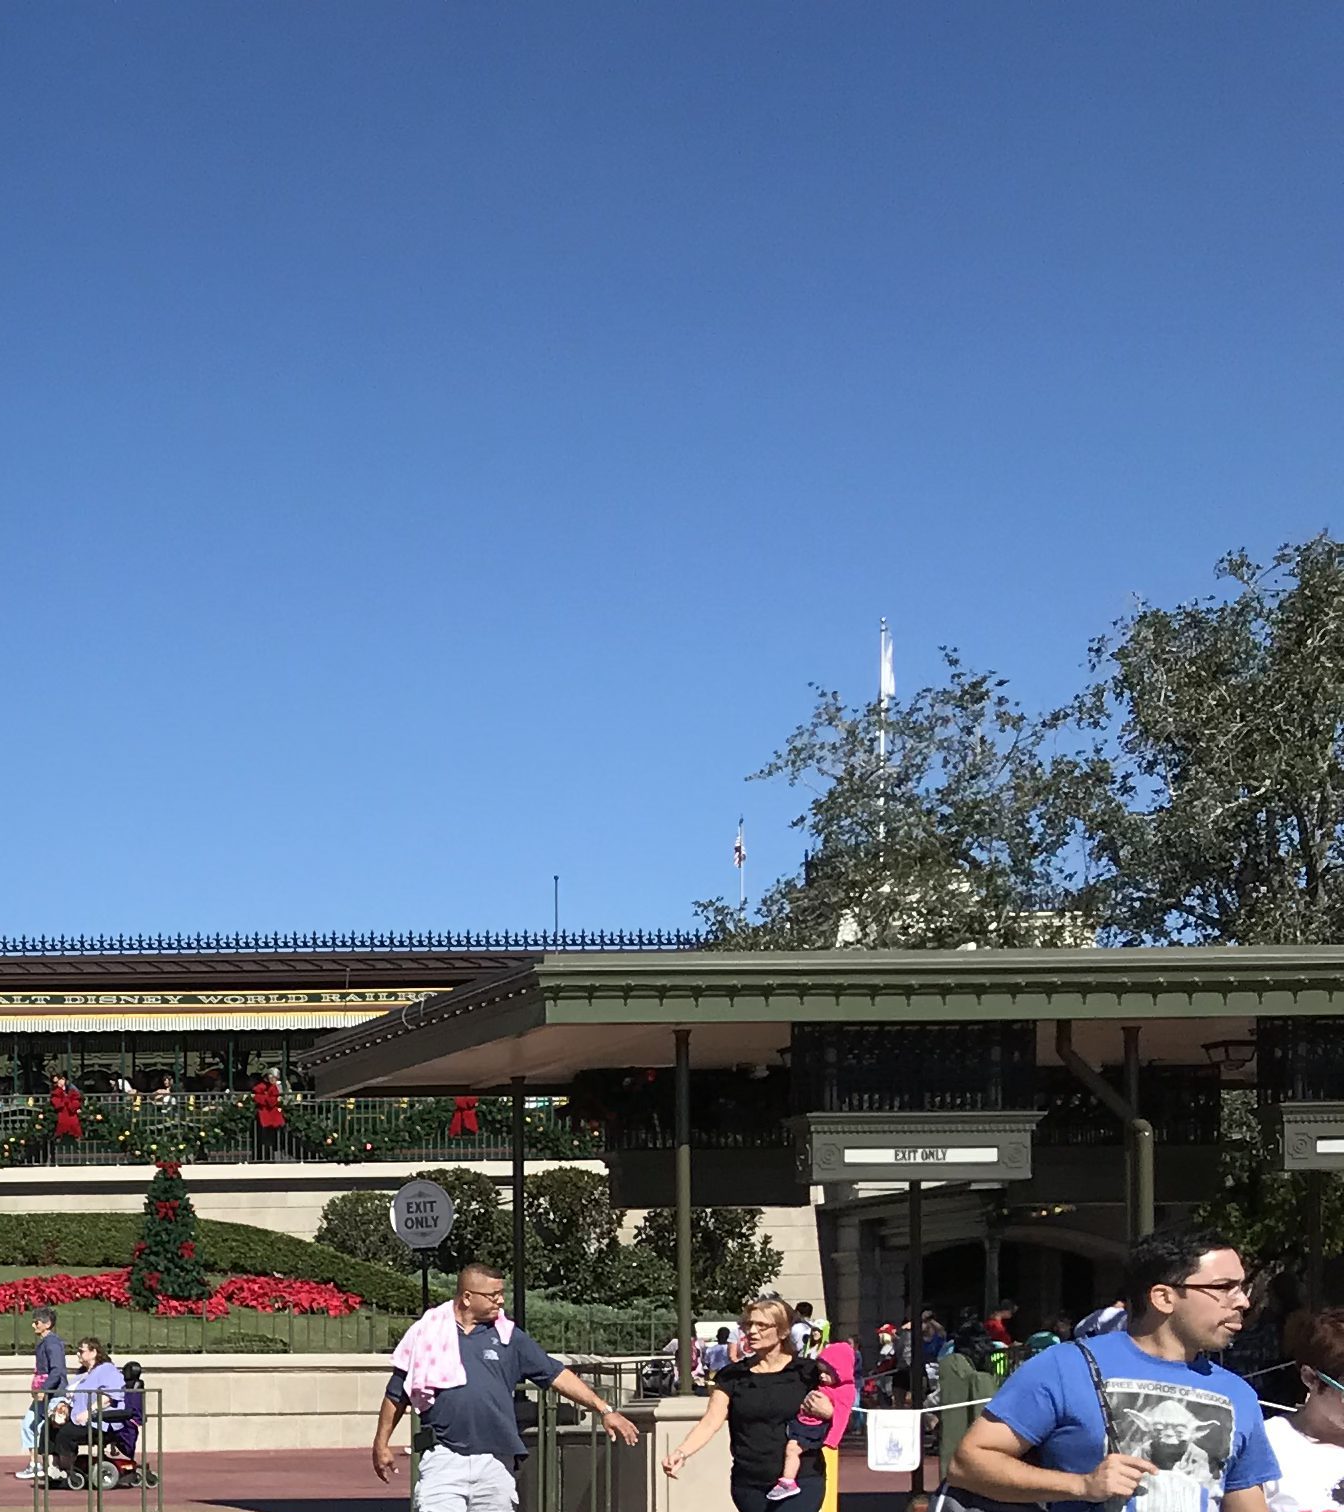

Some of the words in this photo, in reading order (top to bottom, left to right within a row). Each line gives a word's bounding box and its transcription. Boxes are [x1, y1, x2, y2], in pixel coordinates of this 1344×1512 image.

[64, 995, 183, 1004] DISNEY
[197, 994, 309, 1004] WORLD
[321, 992, 438, 1003] RAILRO
[894, 1149, 918, 1161] EXIT
[921, 1149, 948, 1161] ONLY
[406, 1201, 437, 1214] EXIT
[404, 1215, 439, 1229] ONLY
[1136, 1382, 1177, 1394] WORDS
